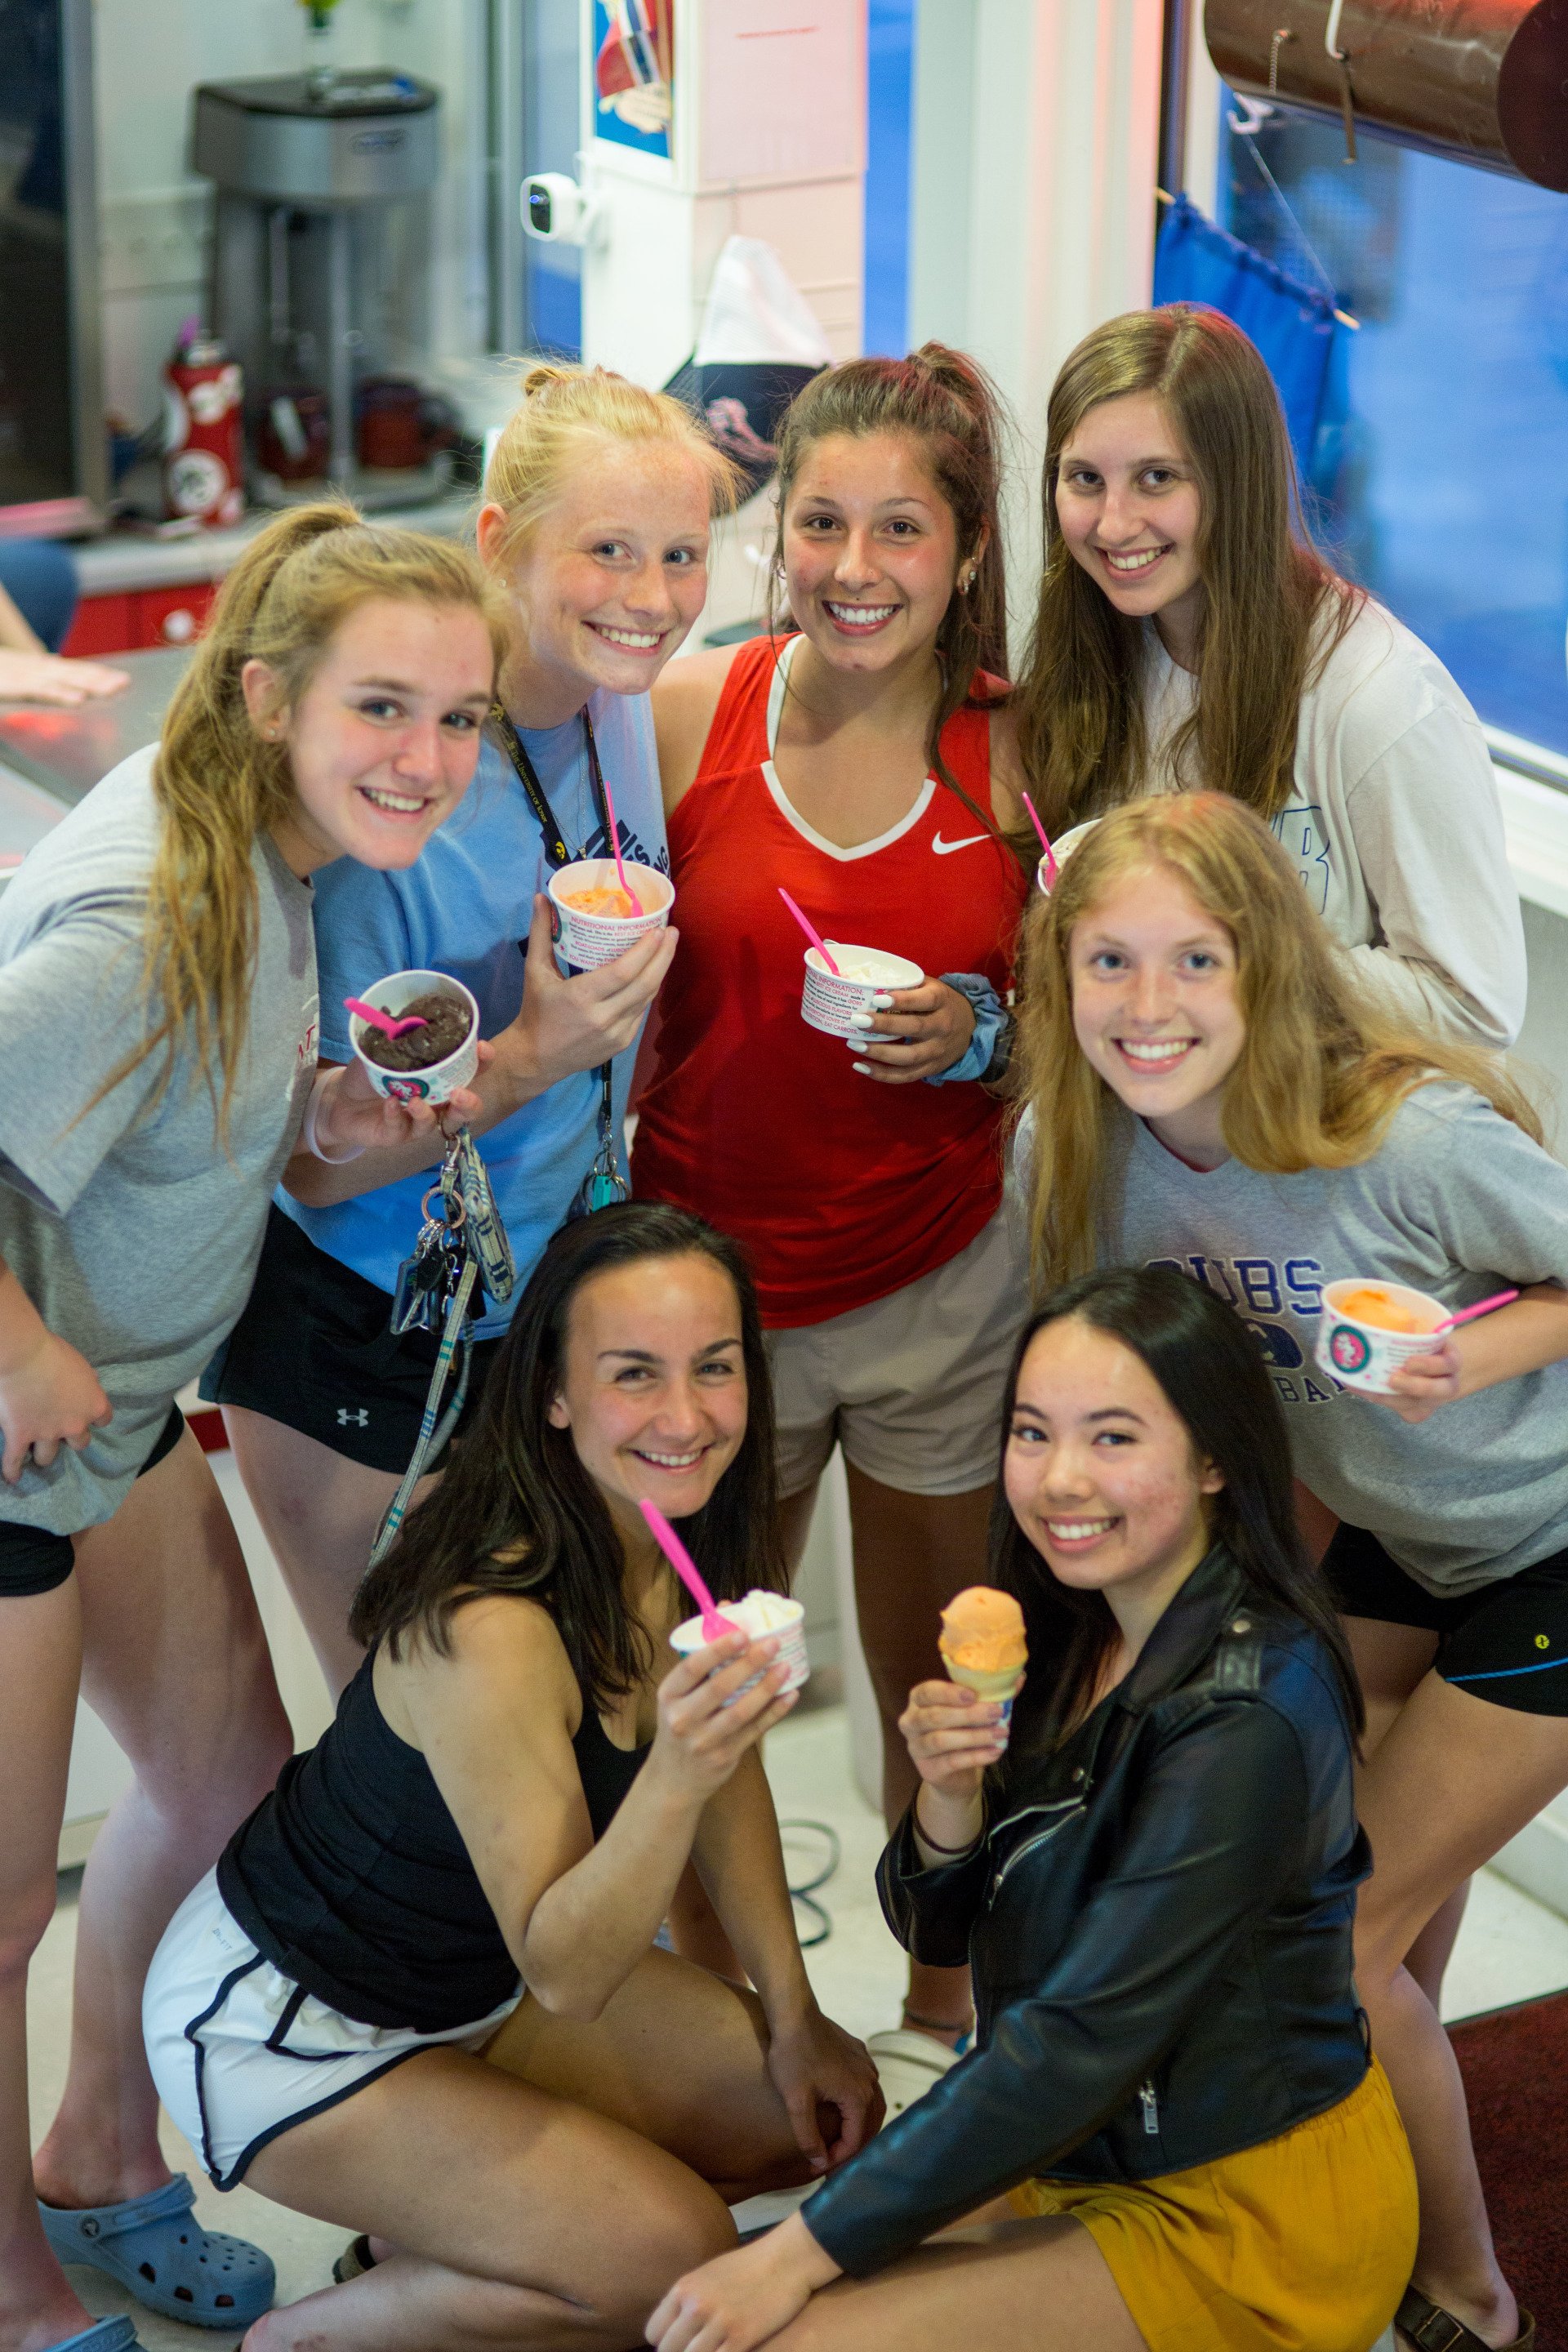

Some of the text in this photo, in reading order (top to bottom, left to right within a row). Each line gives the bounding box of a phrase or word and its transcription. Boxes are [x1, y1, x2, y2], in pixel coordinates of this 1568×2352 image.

[517, 762, 537, 796] UNIVERSITY
[571, 915, 615, 931] NUTRITIONAL
[580, 959, 596, 967] WANT
[818, 975, 864, 996] INFORMATION:
[831, 988, 849, 998] CREAM
[1144, 1254, 1324, 1316] UBS
